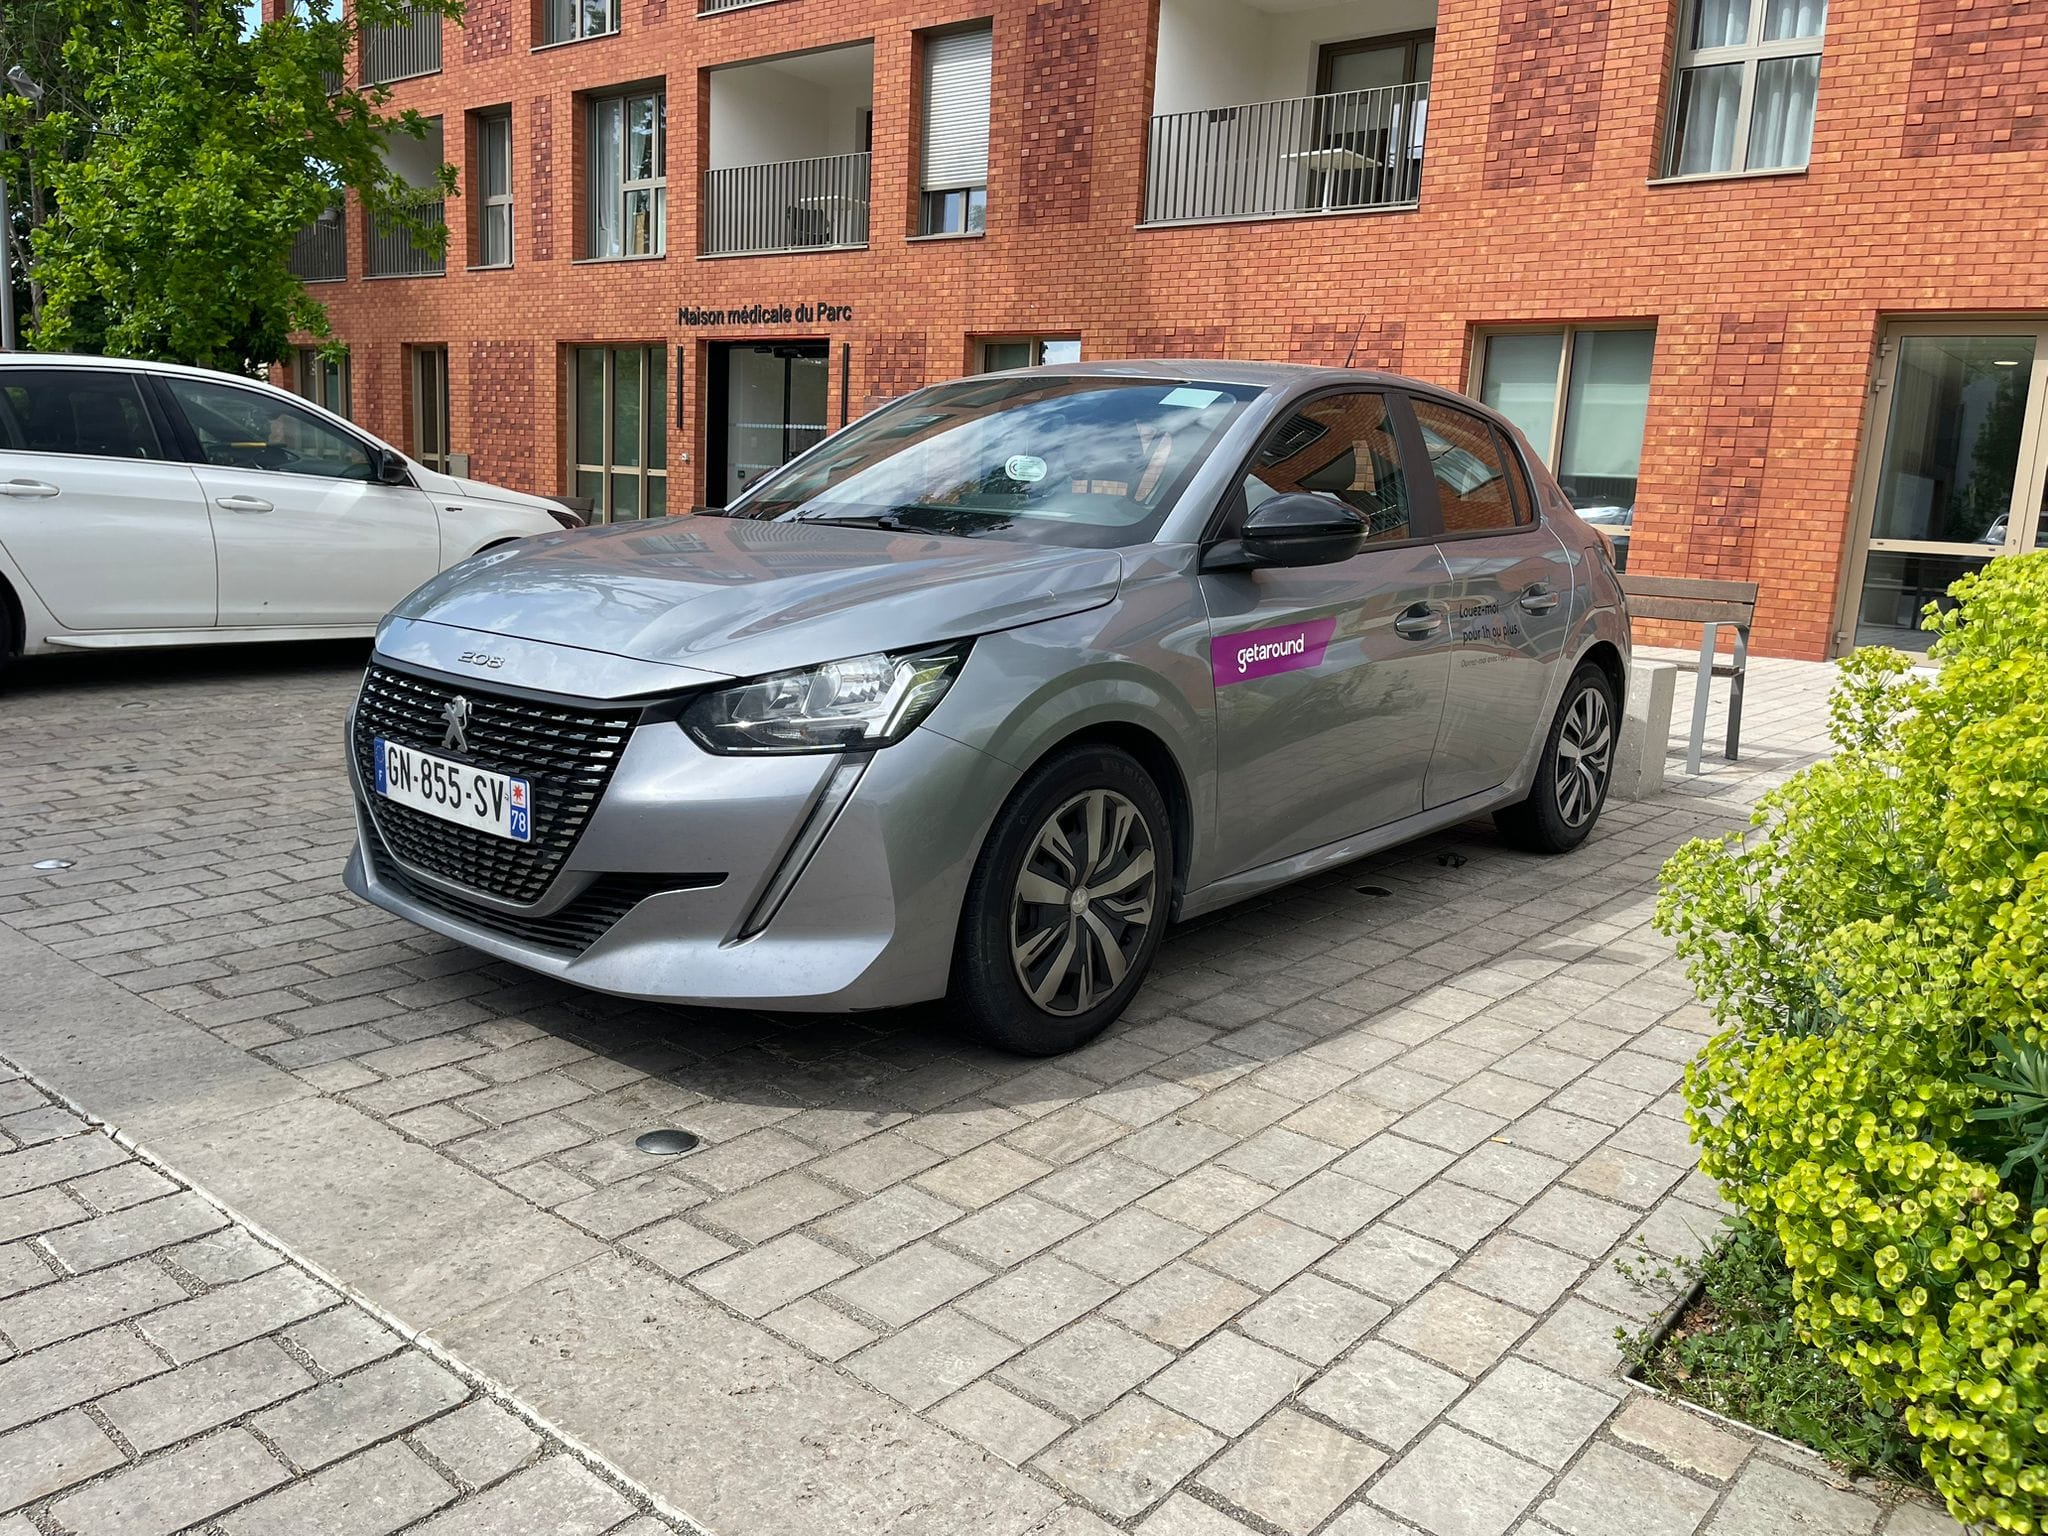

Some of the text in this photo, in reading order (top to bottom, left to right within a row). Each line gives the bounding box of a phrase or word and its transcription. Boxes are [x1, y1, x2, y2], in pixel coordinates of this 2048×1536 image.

[678, 302, 852, 326] Maison médicale du Parc
[1459, 600, 1499, 618] Louez-moi
[1463, 621, 1520, 646] pour 1h ou plus.
[457, 651, 506, 669] 208
[1237, 632, 1305, 674] getaround
[378, 770, 383, 781] F
[388, 746, 504, 822] GN-855-SV
[511, 809, 526, 832] 78
